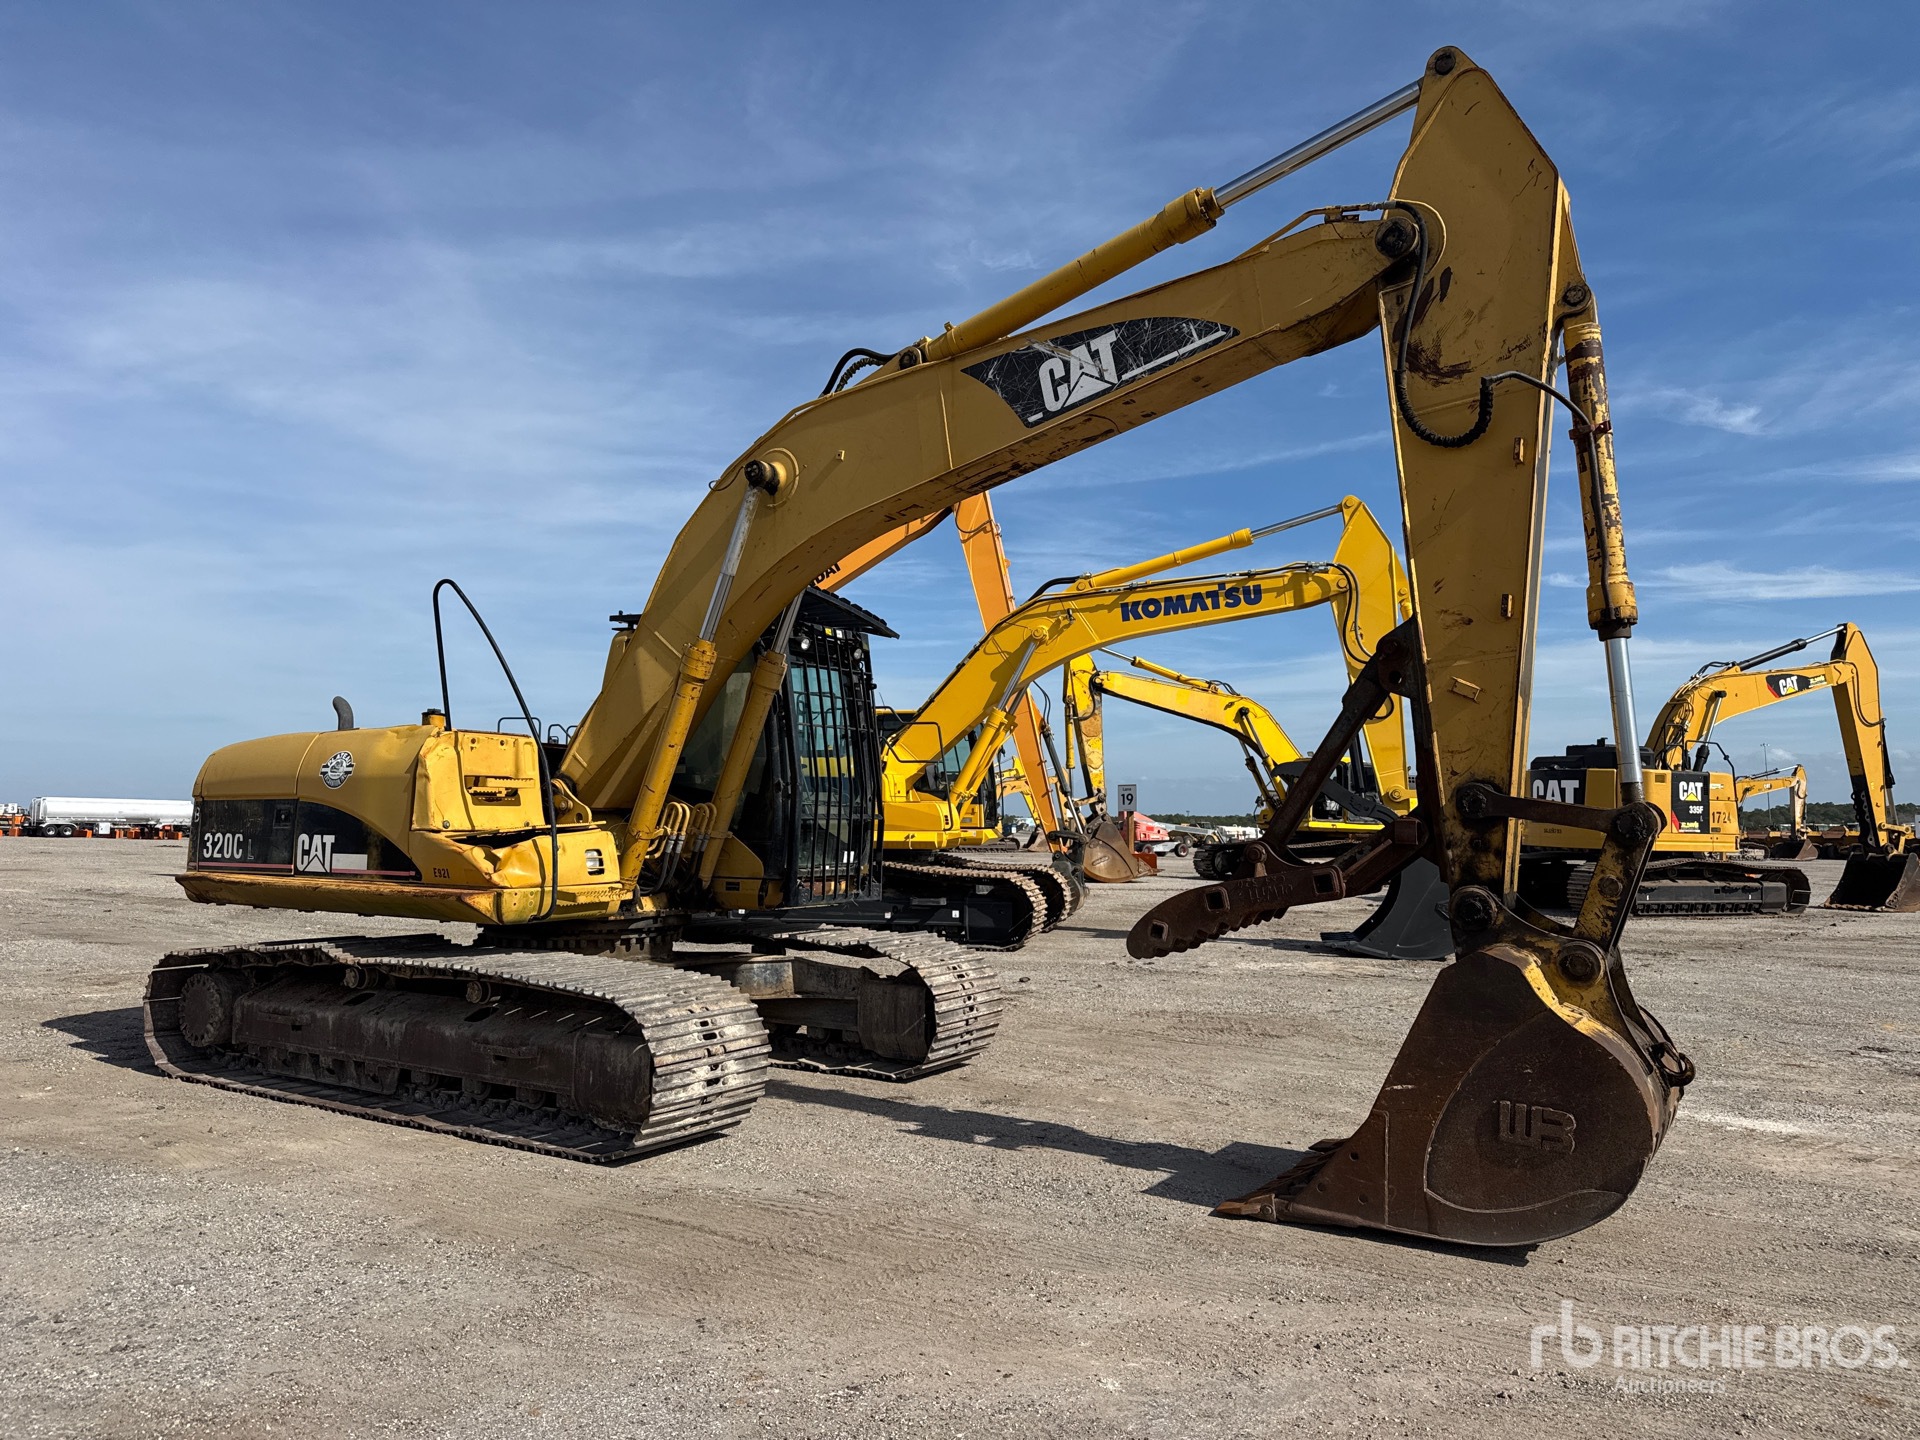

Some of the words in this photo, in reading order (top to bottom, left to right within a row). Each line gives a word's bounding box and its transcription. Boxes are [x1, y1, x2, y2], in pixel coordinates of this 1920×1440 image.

[1038, 329, 1118, 412] CAT
[1120, 582, 1263, 622] KOMATSU
[1778, 675, 1799, 696] CAT
[1120, 793, 1134, 806] 19
[1532, 779, 1580, 805] CAT
[1678, 781, 1704, 802] CAT
[1689, 805, 1704, 814] 335F
[1711, 811, 1732, 824] 1724
[203, 832, 243, 860] 320C
[247, 838, 255, 860] L
[296, 833, 336, 874] CAT
